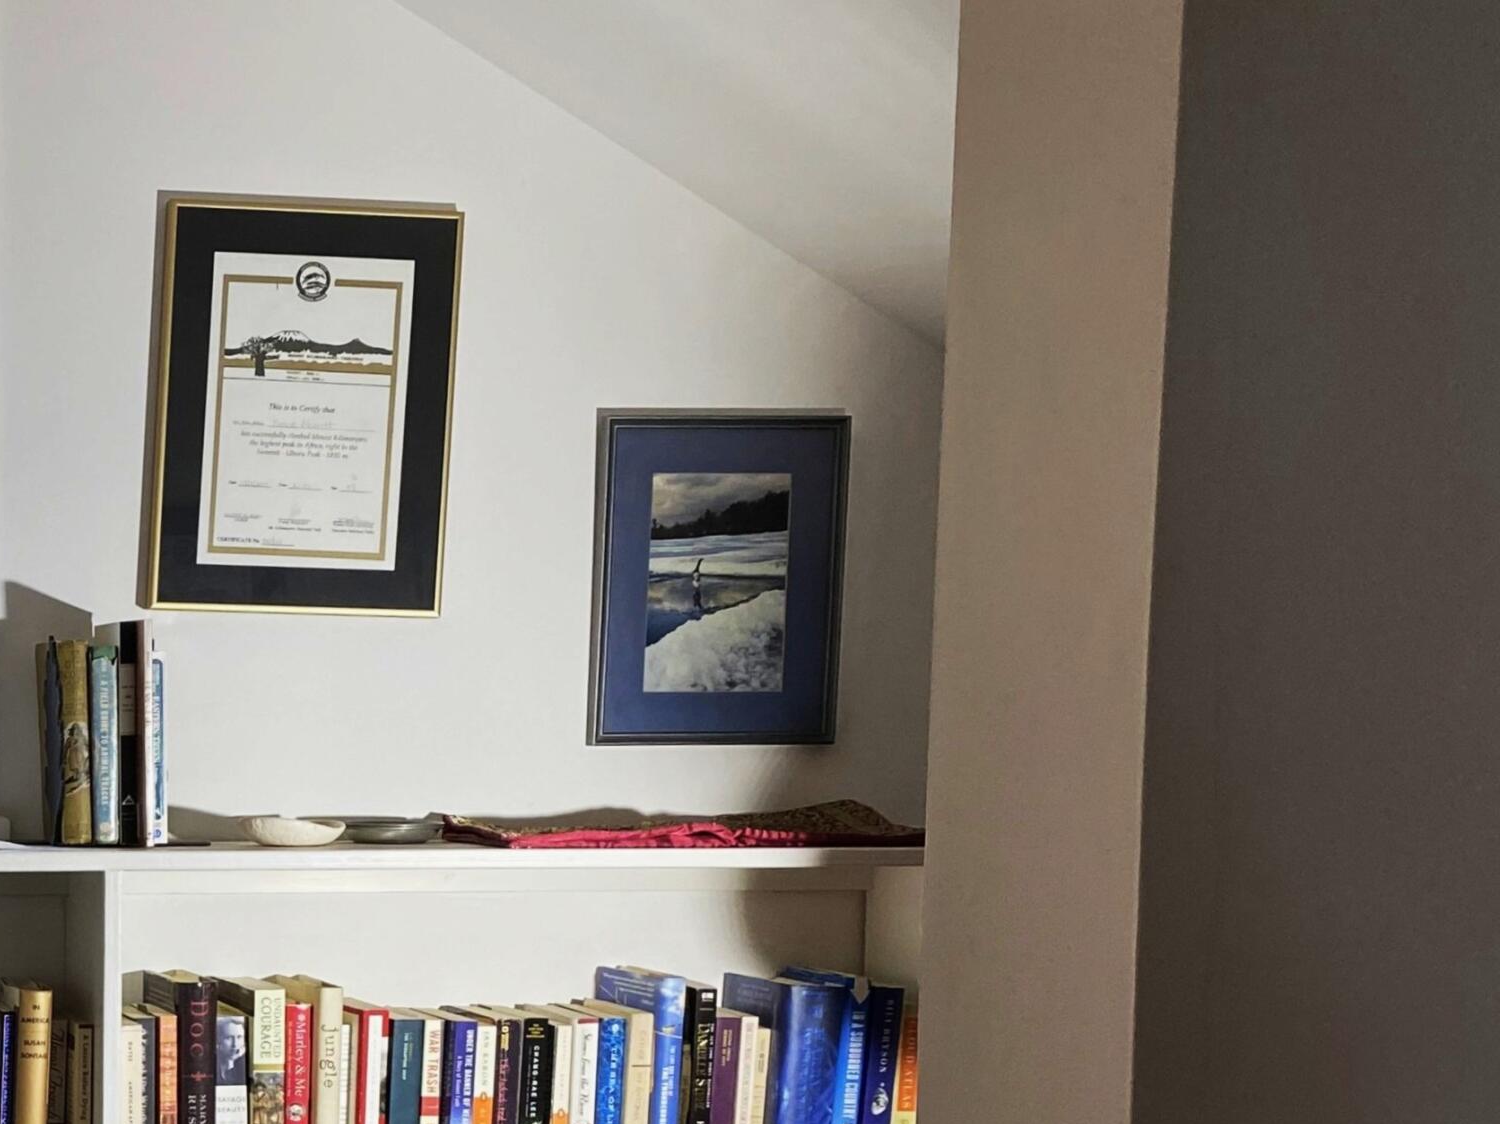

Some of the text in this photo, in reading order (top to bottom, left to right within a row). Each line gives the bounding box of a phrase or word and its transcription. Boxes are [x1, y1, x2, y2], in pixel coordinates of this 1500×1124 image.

[259, 996, 272, 1059] COURAGE
[320, 1024, 338, 1088] jungle
[465, 1029, 474, 1052] UNDER
[292, 1022, 308, 1097] Marley & Me
[427, 1029, 441, 1094] WAR TRASH
[464, 1054, 474, 1067] THE
[901, 1071, 915, 1109] ATLAS
